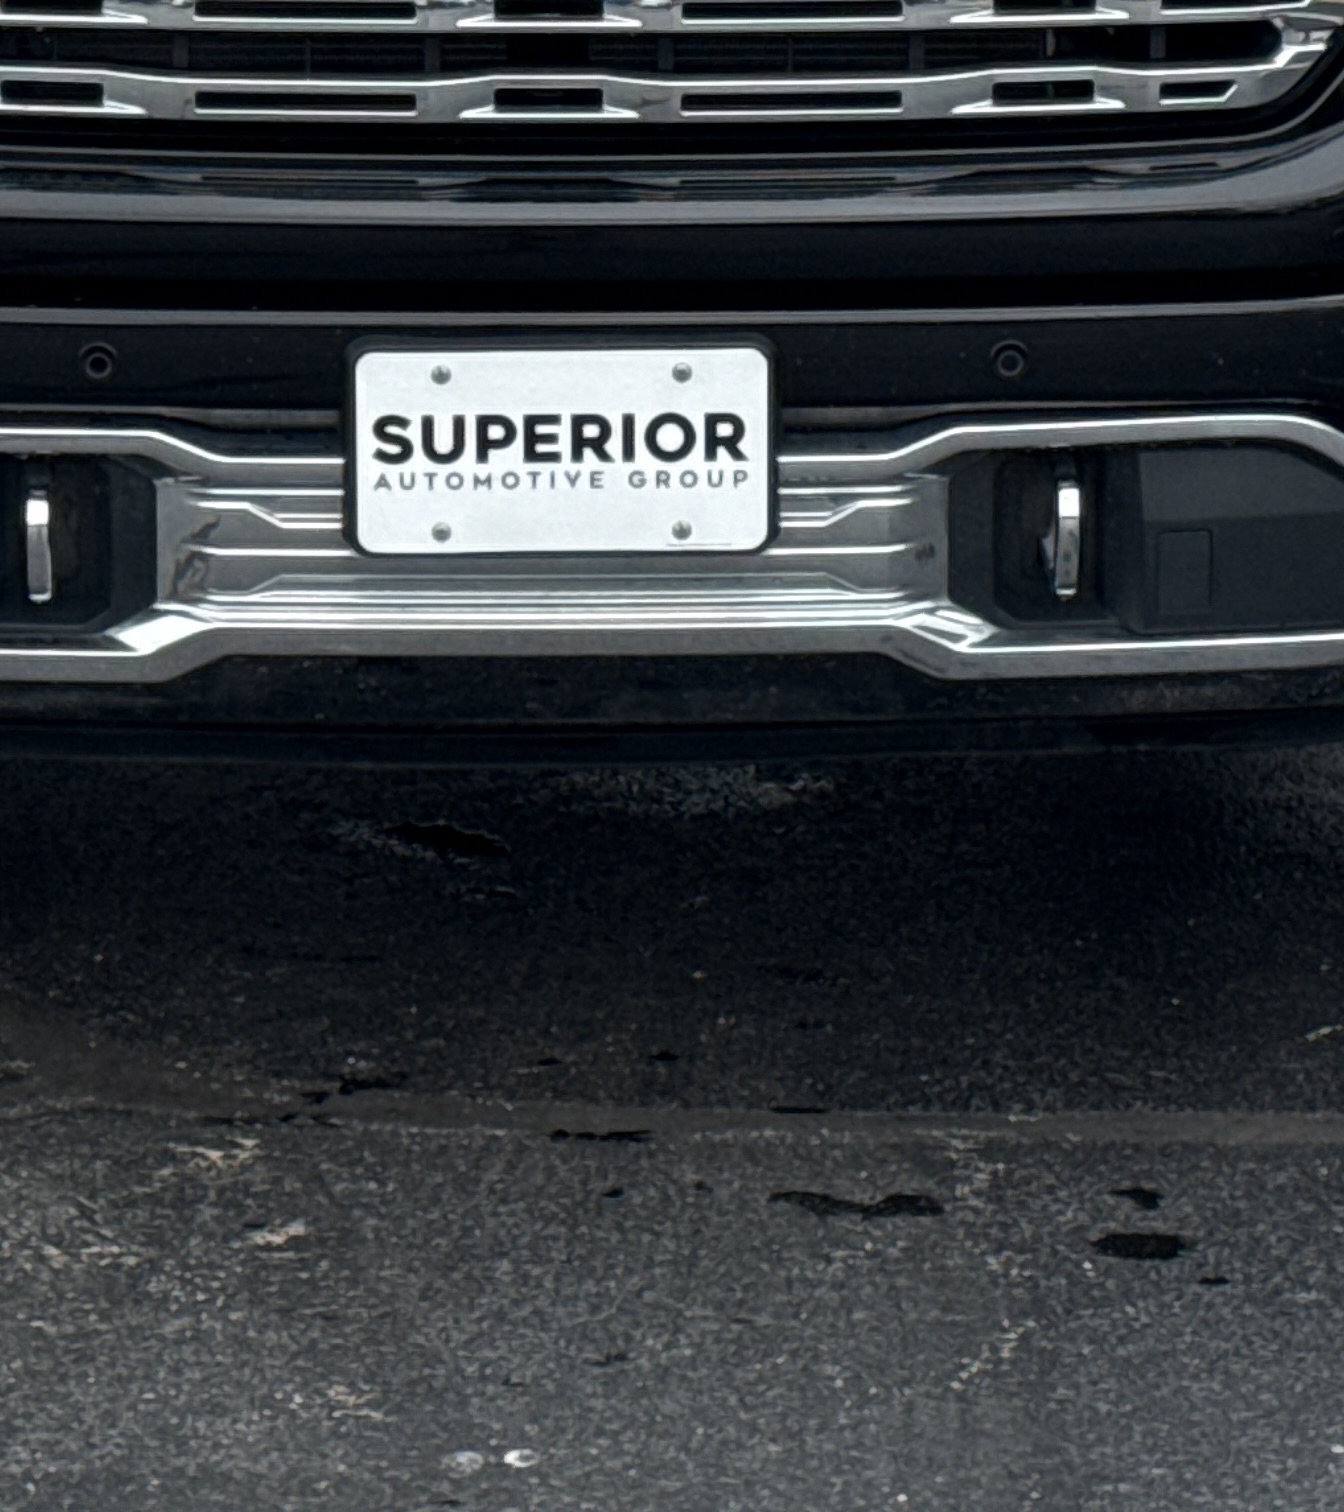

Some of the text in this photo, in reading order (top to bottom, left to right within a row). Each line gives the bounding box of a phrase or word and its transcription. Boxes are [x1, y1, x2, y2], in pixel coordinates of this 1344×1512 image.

[371, 412, 749, 465] SUPERIOR
[373, 469, 749, 490] AUTOMOTIVE GROUP
